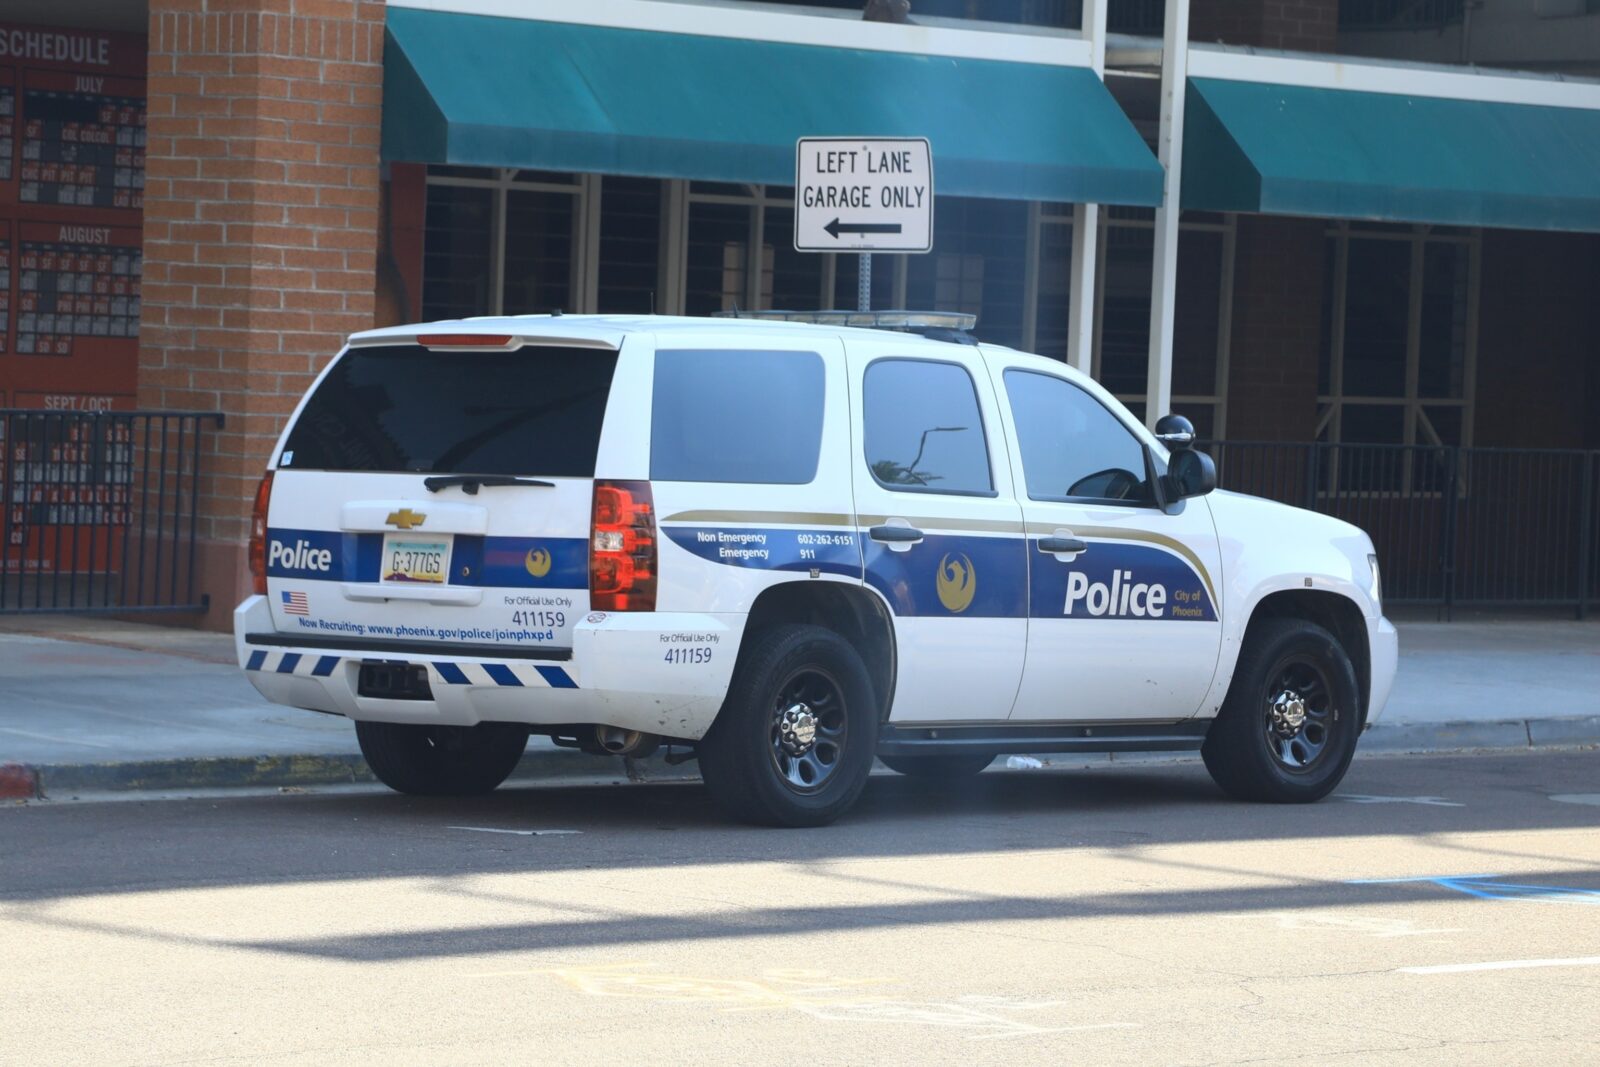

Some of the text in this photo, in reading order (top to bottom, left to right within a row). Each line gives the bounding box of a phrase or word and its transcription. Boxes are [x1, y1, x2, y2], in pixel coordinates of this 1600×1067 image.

[0, 28, 110, 65] SCHEDULE
[75, 76, 104, 93] JULY
[816, 151, 912, 173] LEFT LANE
[803, 186, 924, 208] GARAGE ONLY
[58, 225, 111, 244] AUGUST
[697, 532, 854, 545] Non Emergency 602-262-6151
[268, 539, 332, 571] Police
[719, 548, 815, 560] Emergency 911
[1063, 569, 1167, 617] Police
[1174, 590, 1201, 603] City of
[504, 596, 572, 608] For Official Use Only
[512, 610, 565, 627] 411159
[1172, 606, 1203, 616] Phoenix
[298, 617, 317, 628] Now
[319, 619, 366, 635] Recruiting:
[660, 633, 720, 644] For Official Use Only
[664, 647, 712, 664] 411159
